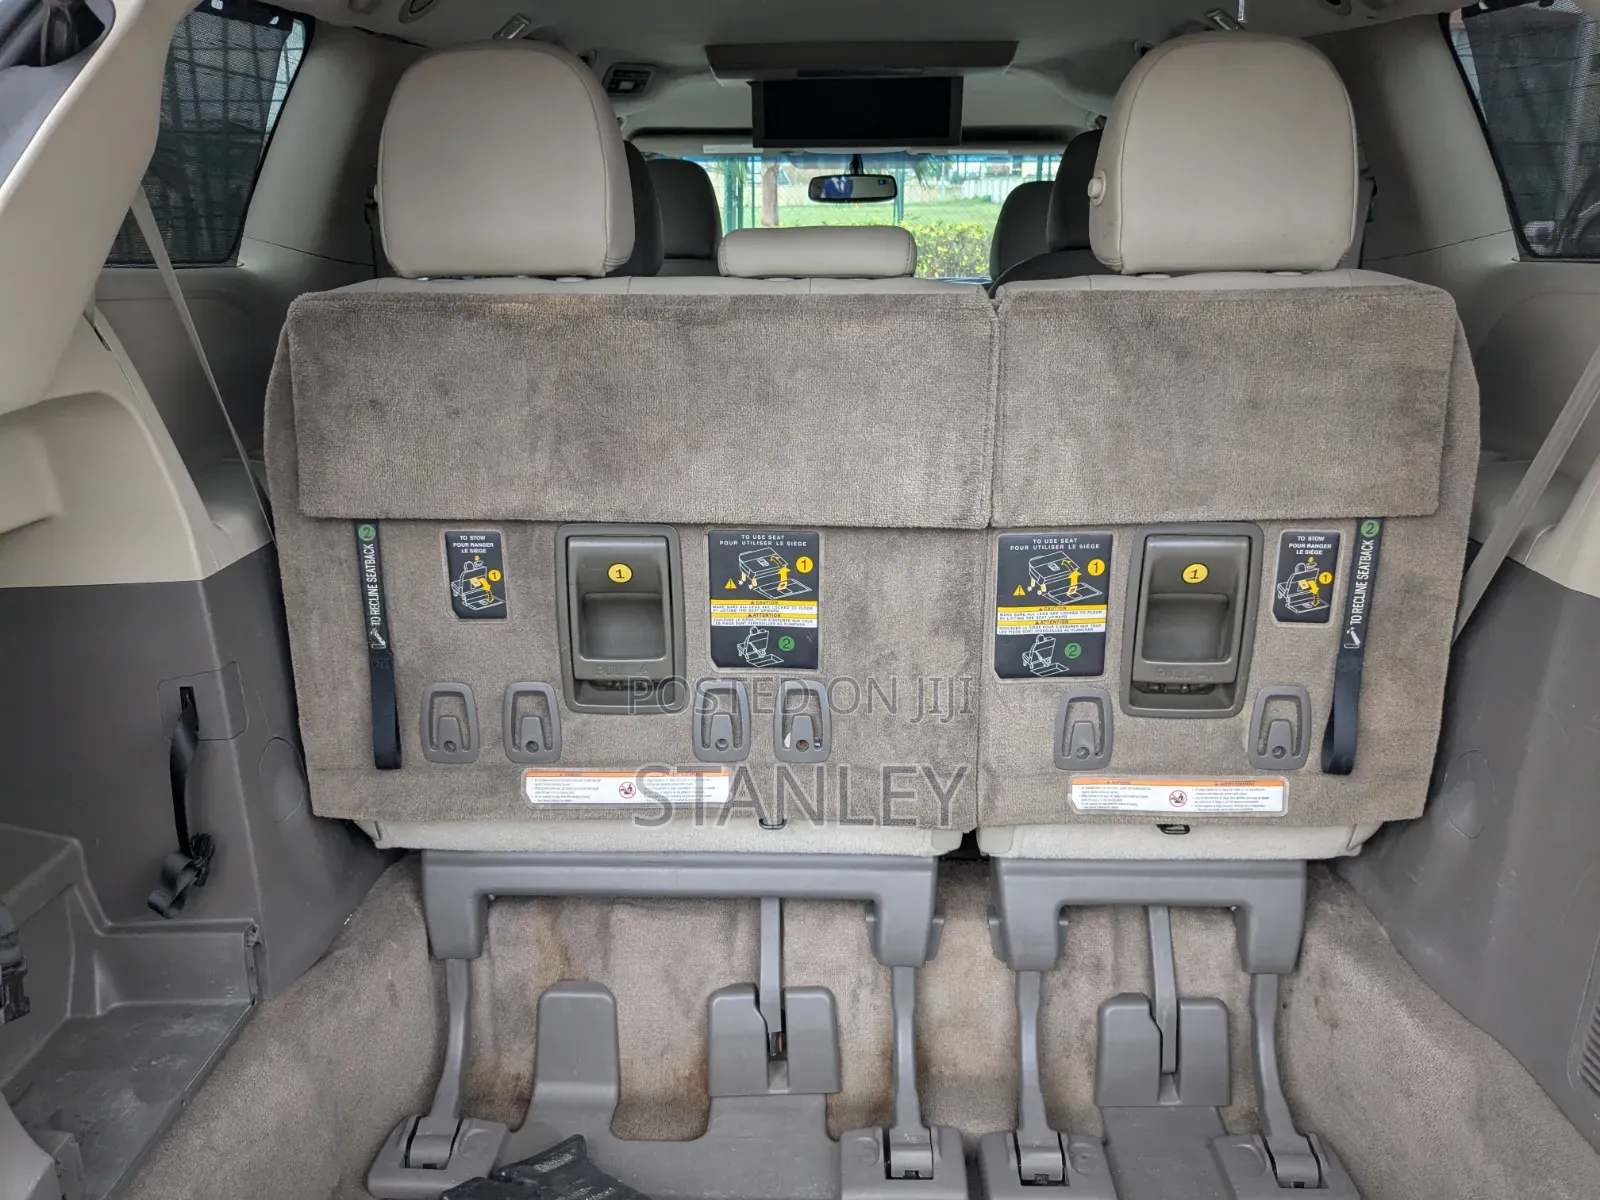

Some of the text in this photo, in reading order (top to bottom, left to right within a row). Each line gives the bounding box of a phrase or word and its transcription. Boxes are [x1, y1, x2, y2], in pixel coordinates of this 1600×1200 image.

[363, 527, 371, 539] 2
[1366, 523, 1375, 535] 2
[615, 568, 625, 579] 1
[1189, 568, 1199, 580] 1
[363, 543, 382, 626] TO RECLINE SEATBACK
[1350, 539, 1375, 625] TO RECLINE SEATBACK
[782, 638, 791, 650] 2
[1068, 644, 1078, 657] 2
